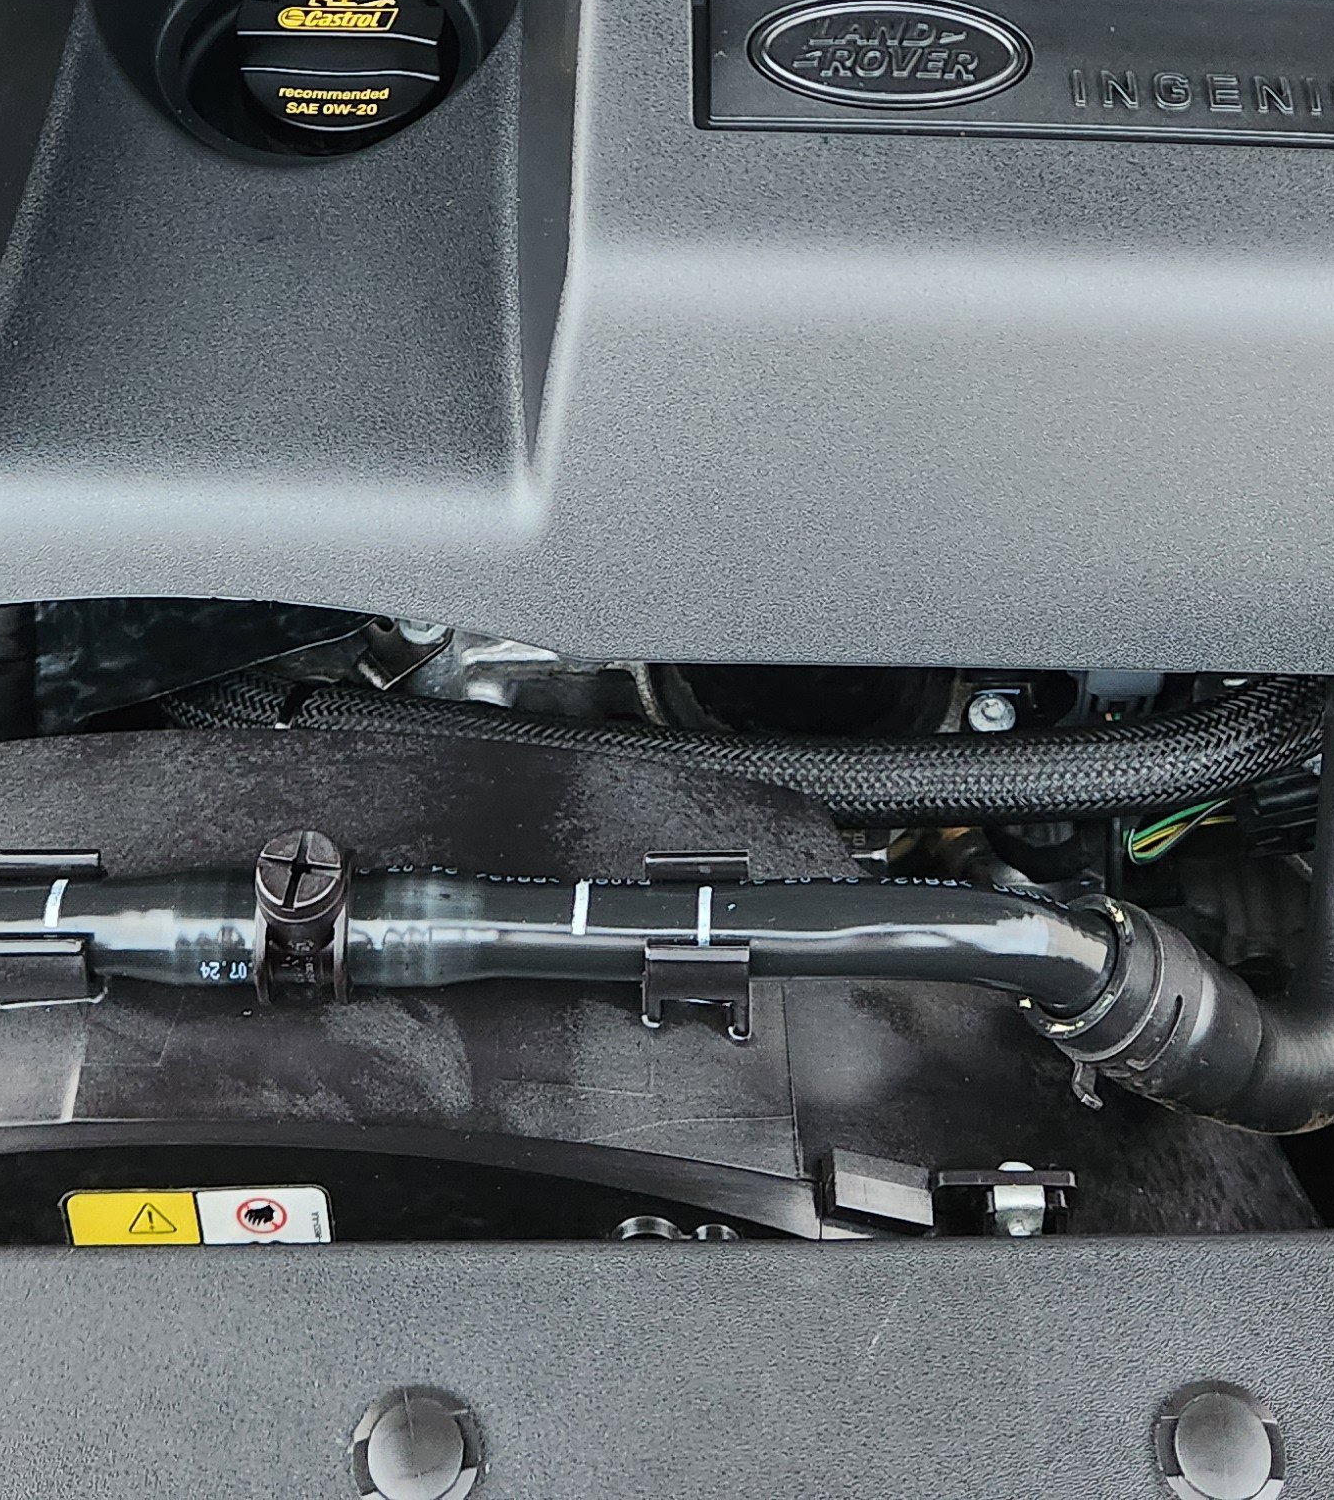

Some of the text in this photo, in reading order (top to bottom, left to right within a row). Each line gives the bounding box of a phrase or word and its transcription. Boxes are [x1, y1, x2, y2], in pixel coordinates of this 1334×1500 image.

[304, 10, 381, 28] Castrol
[810, 17, 939, 47] LAND
[817, 45, 978, 82] ROVER
[278, 86, 390, 101] recommended
[285, 101, 319, 115] SAE
